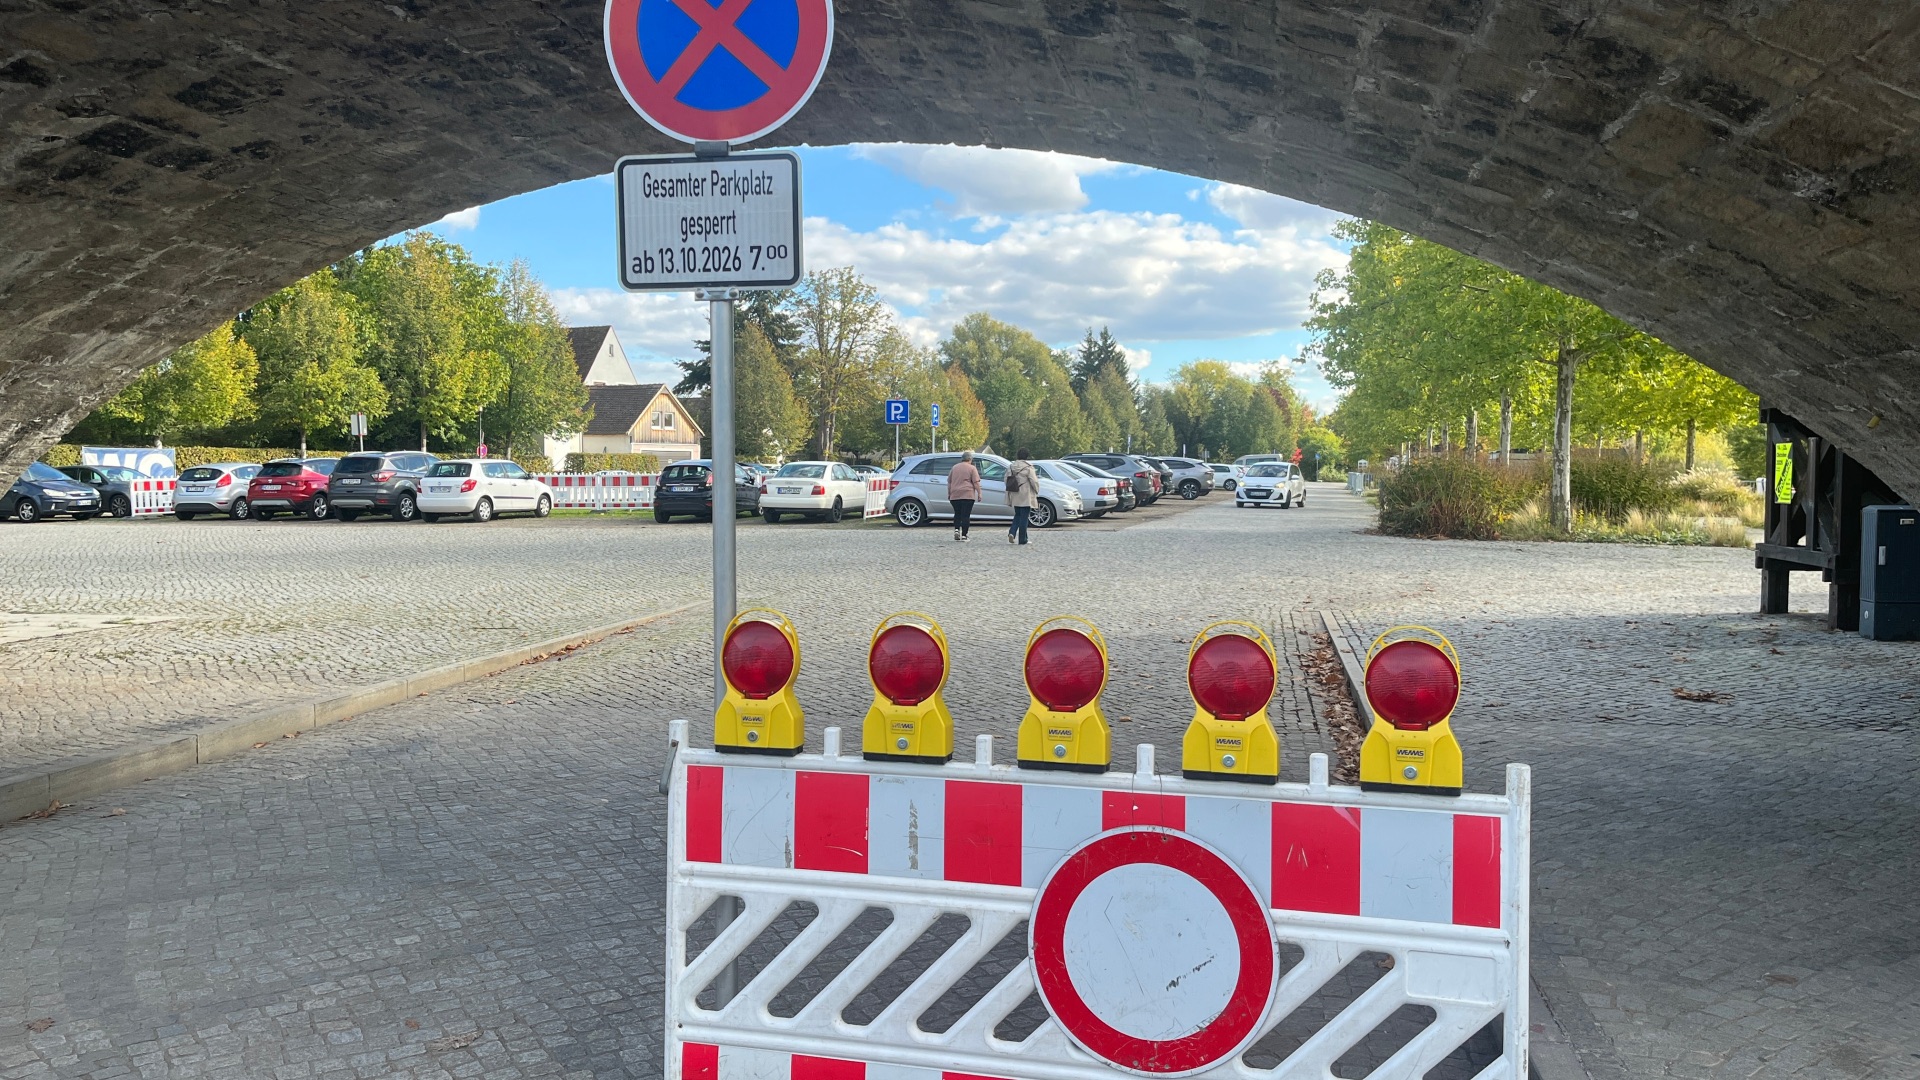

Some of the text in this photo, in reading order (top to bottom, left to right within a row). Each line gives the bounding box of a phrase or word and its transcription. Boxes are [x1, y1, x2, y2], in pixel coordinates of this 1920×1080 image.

[642, 169, 773, 203] Gesamter Parkplatz
[680, 209, 737, 243] gesperrt
[632, 250, 655, 274] ab
[658, 246, 742, 274] 13.10.2026
[891, 403, 904, 420] P
